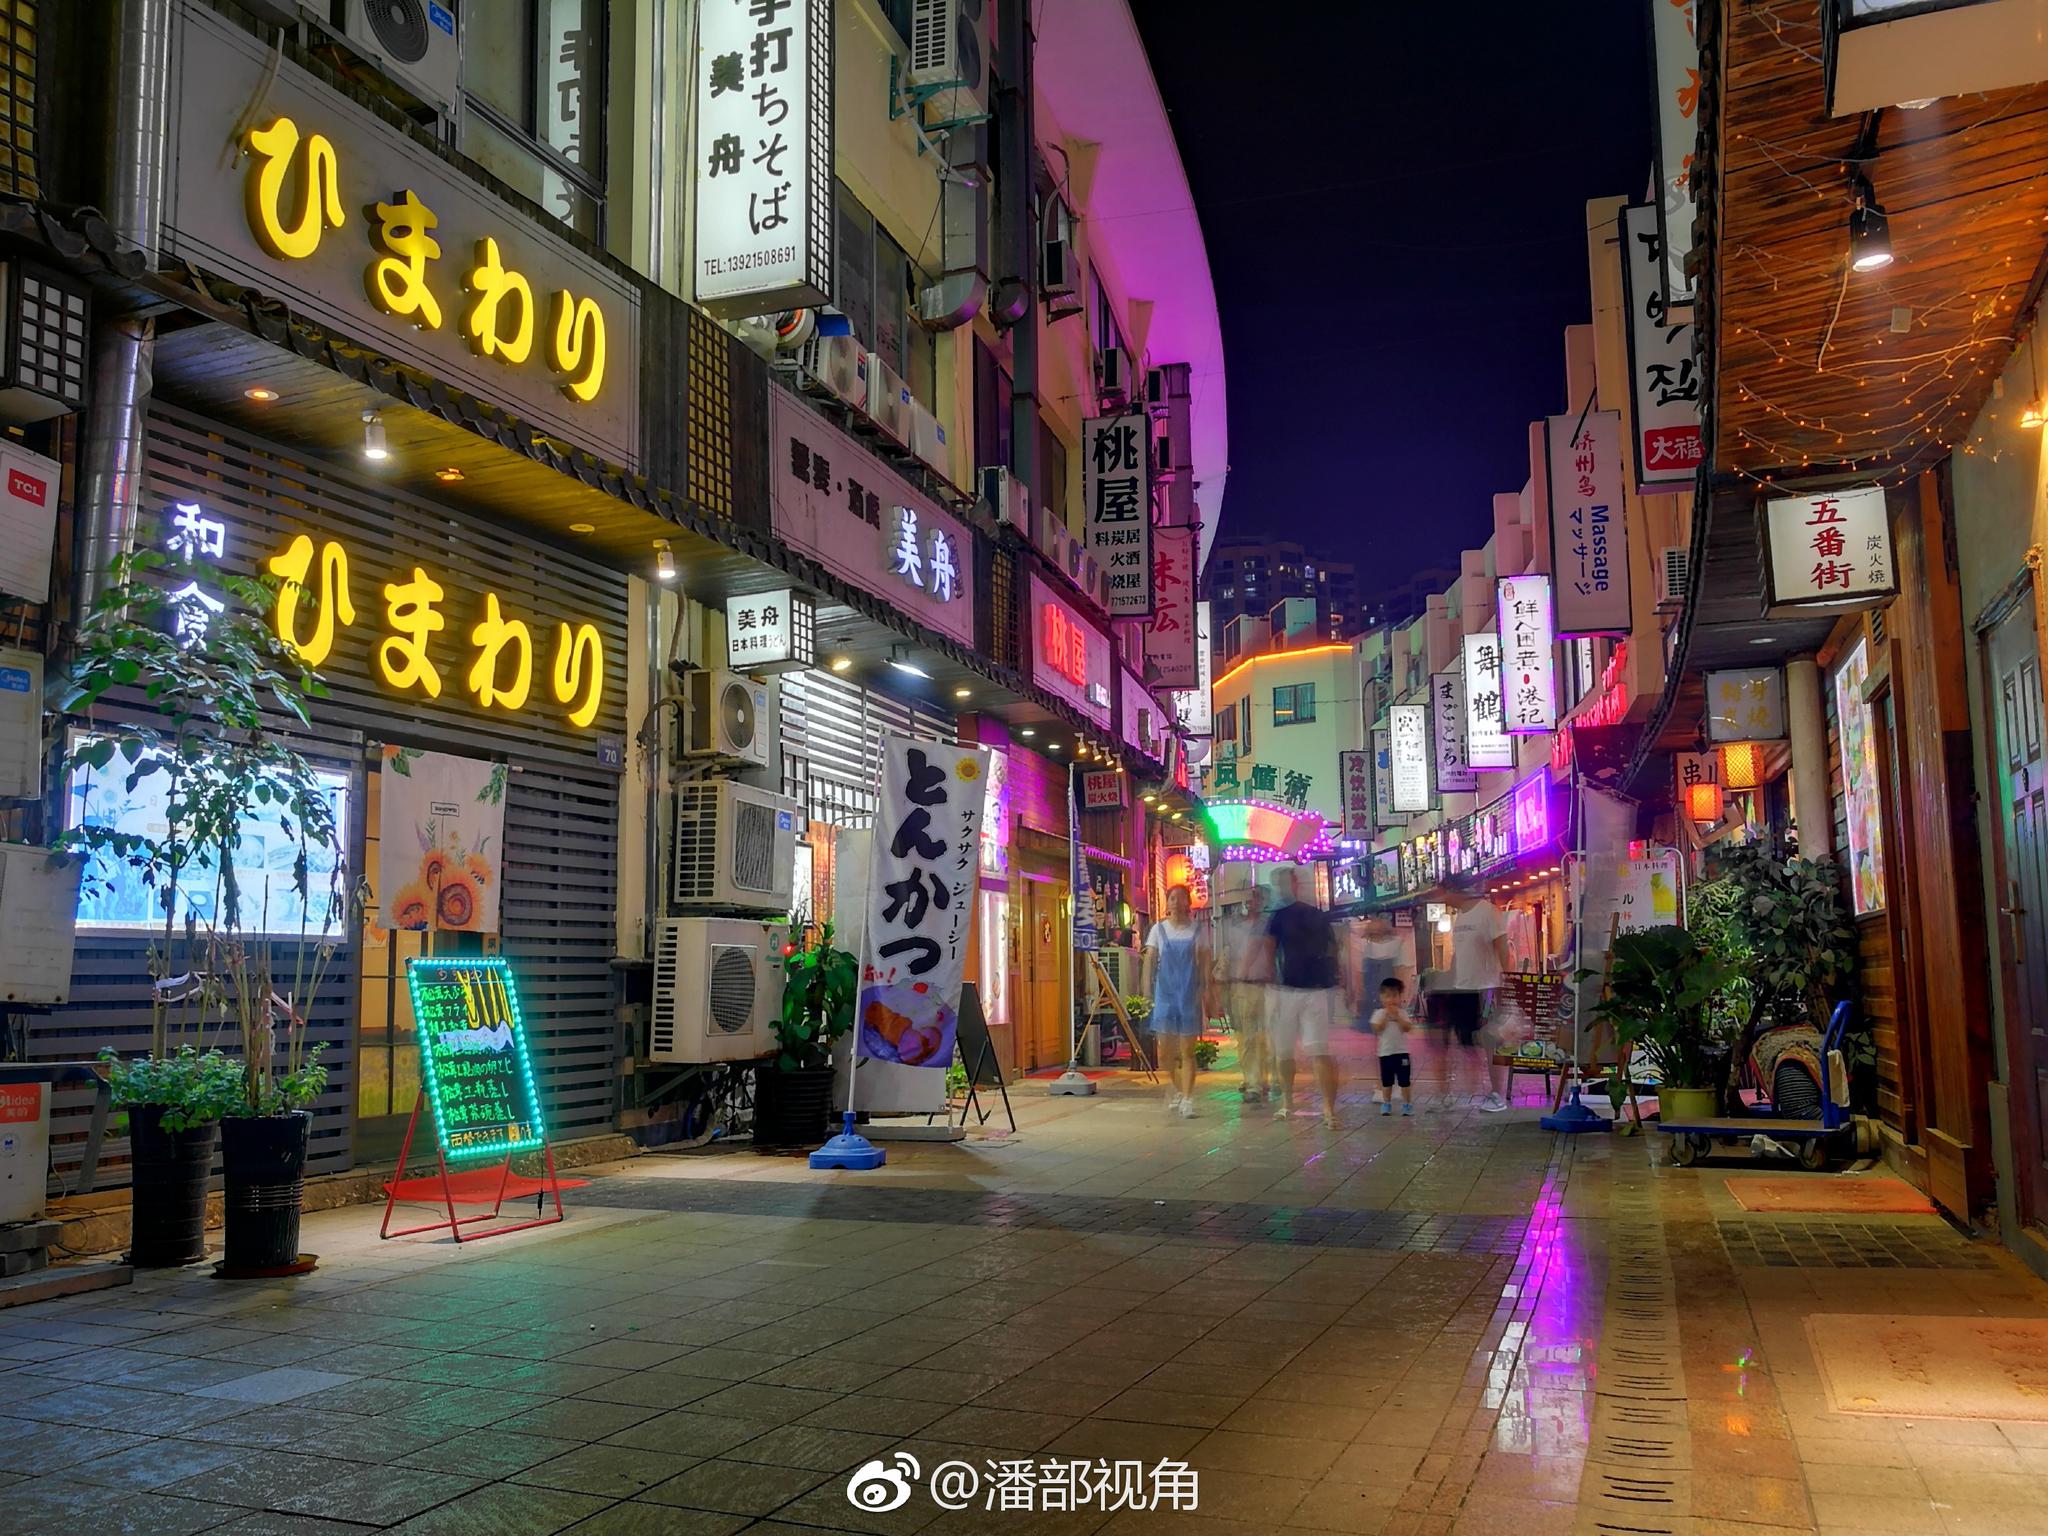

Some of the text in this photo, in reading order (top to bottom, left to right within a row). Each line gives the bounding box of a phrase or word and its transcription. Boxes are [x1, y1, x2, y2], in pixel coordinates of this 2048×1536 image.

[250, 116, 607, 402] ひまわり
[704, 246, 797, 276] TEL:13921508691
[13, 477, 41, 498] TCL
[1092, 425, 1139, 523] 桃屋
[1650, 436, 1701, 465] 大福
[896, 507, 956, 603] 美舟
[1570, 507, 1591, 596] マッサージ
[1591, 505, 1609, 592] Massage
[1805, 499, 1855, 590] 五番街
[267, 533, 605, 729] ひまわり
[738, 605, 779, 631] 美舟
[605, 749, 617, 764] 70
[879, 748, 950, 976] とんかつ
[948, 809, 976, 960] サクサク ジューシー
